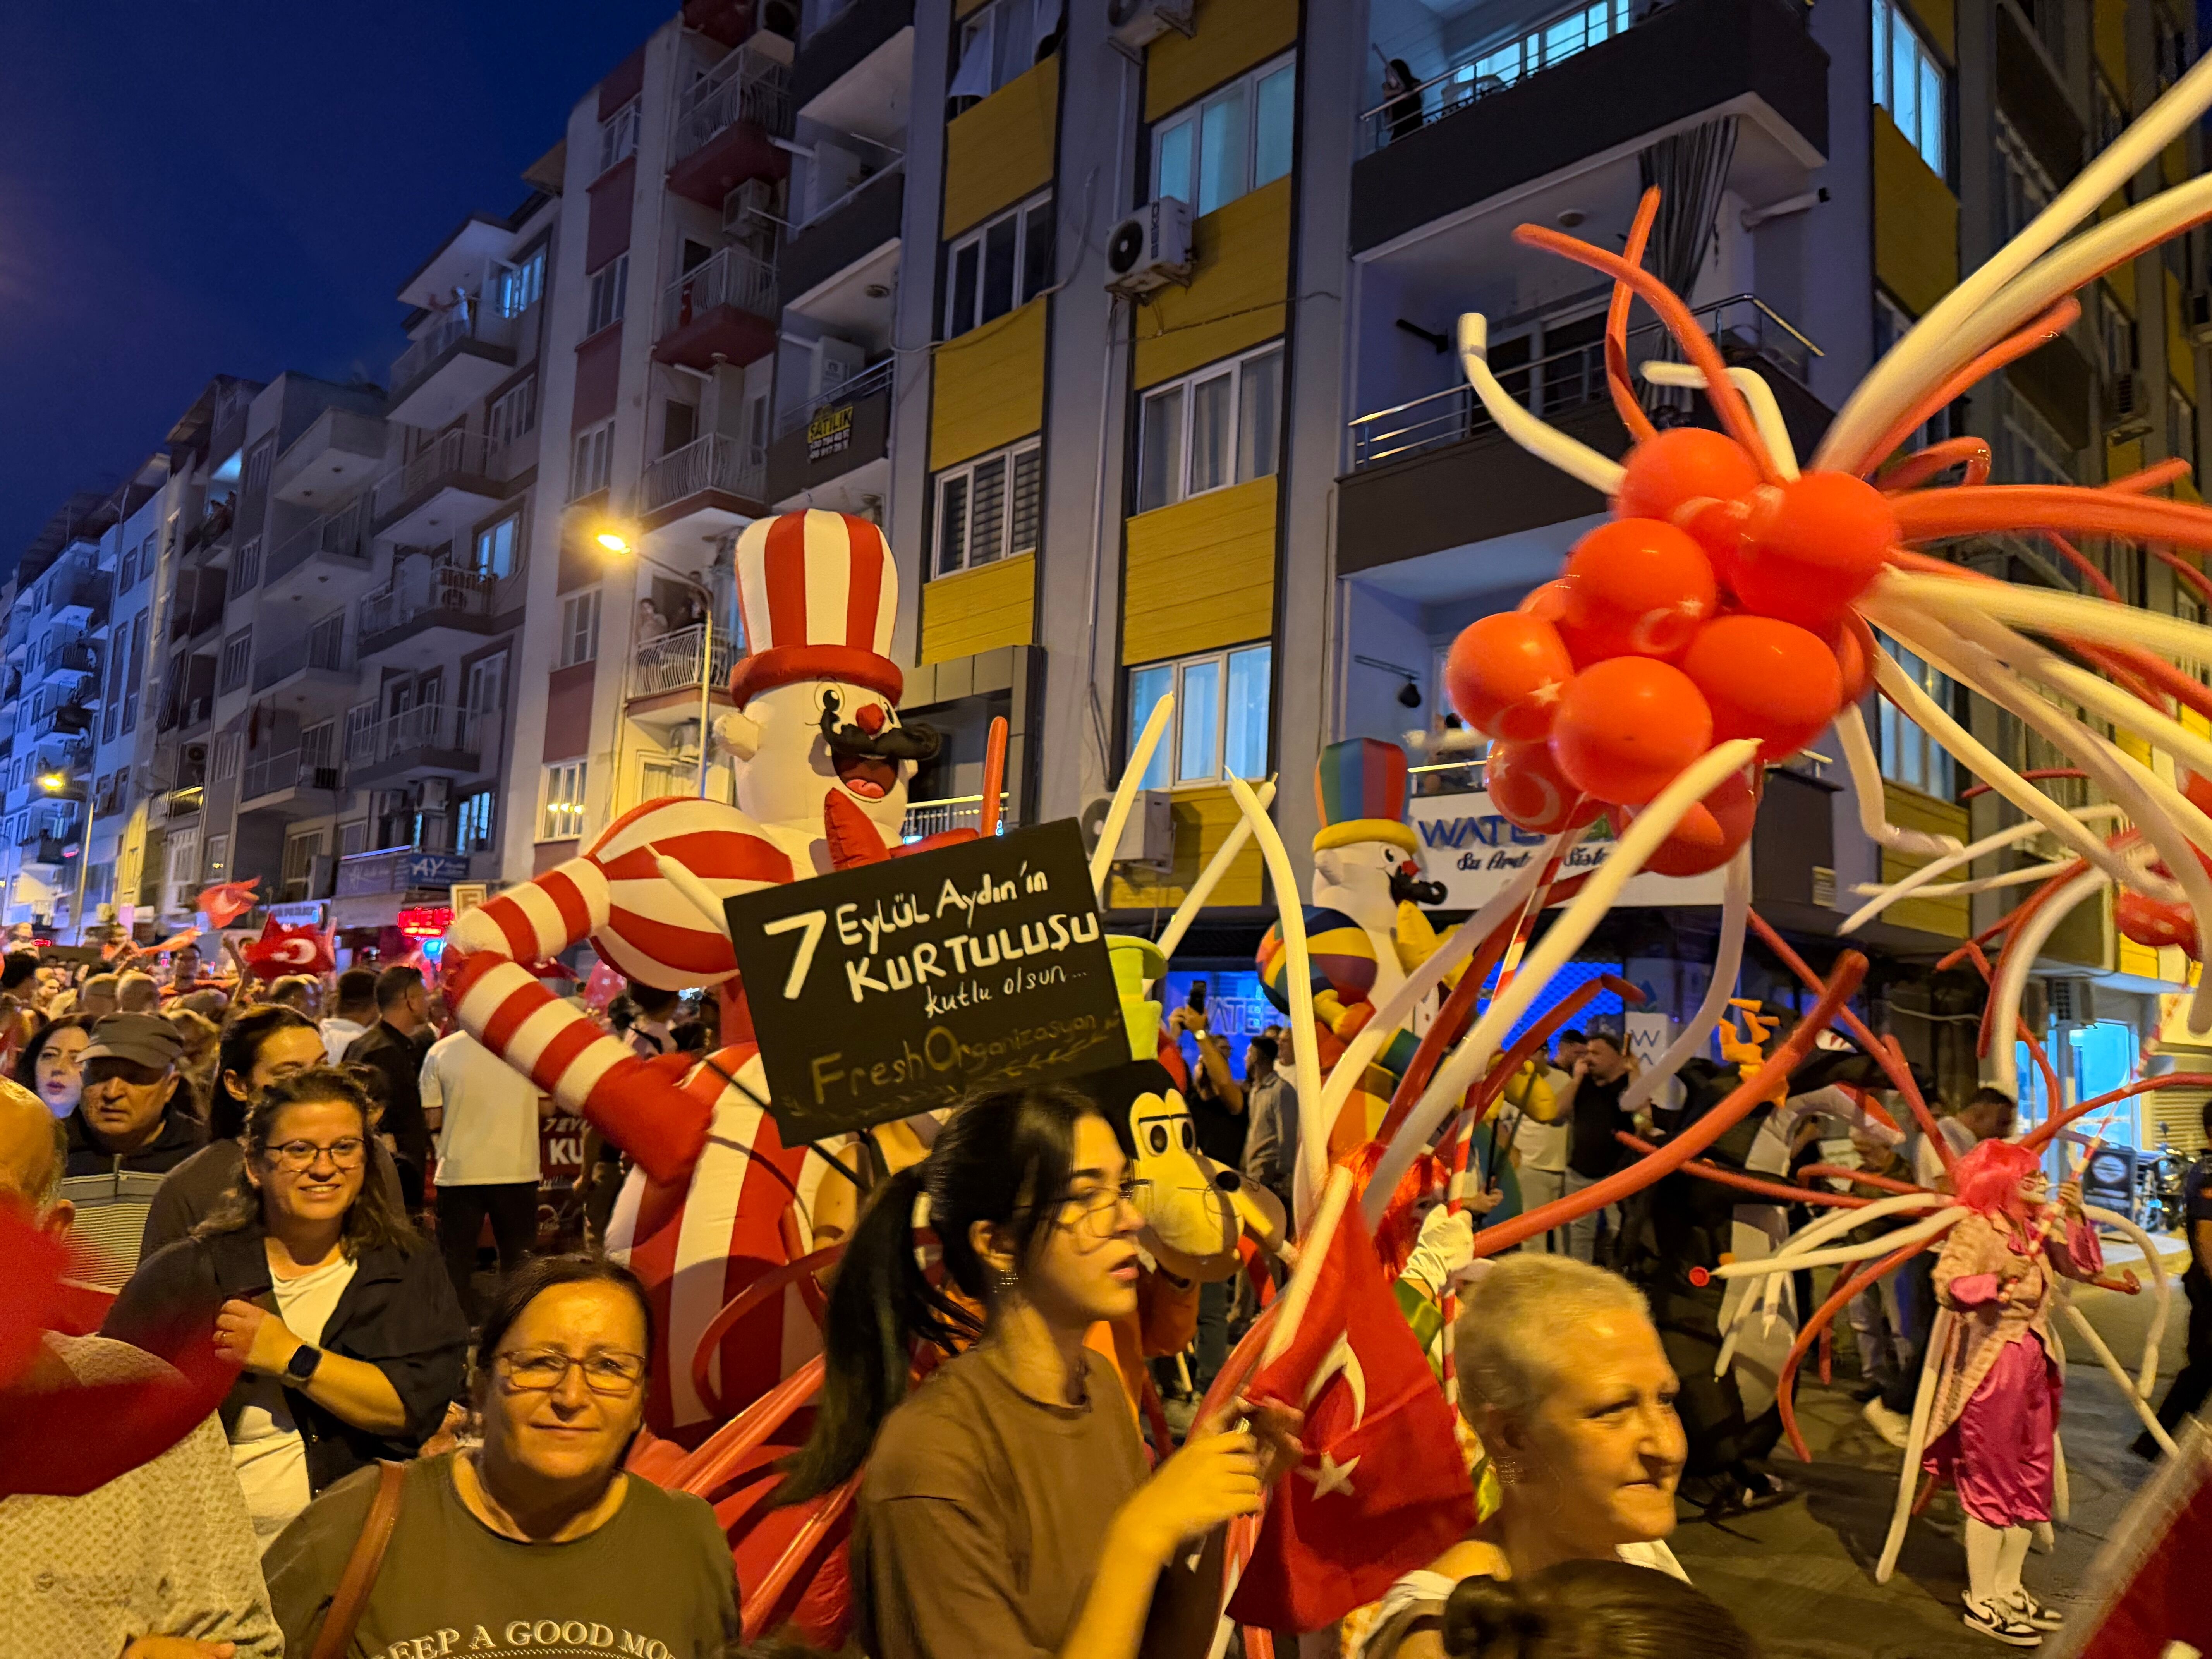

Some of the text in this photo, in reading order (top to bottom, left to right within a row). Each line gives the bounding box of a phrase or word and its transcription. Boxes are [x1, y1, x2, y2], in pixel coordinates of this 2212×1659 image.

[1419, 815, 1546, 848] WATE
[1457, 852, 1481, 871] Su
[764, 909, 827, 1000] 7
[846, 911, 1099, 1003] KURTULUŞU
[925, 979, 992, 1018] kutlu
[550, 1137, 584, 1165] KU
[371, 1620, 676, 1659] EEP A GOOD MO
